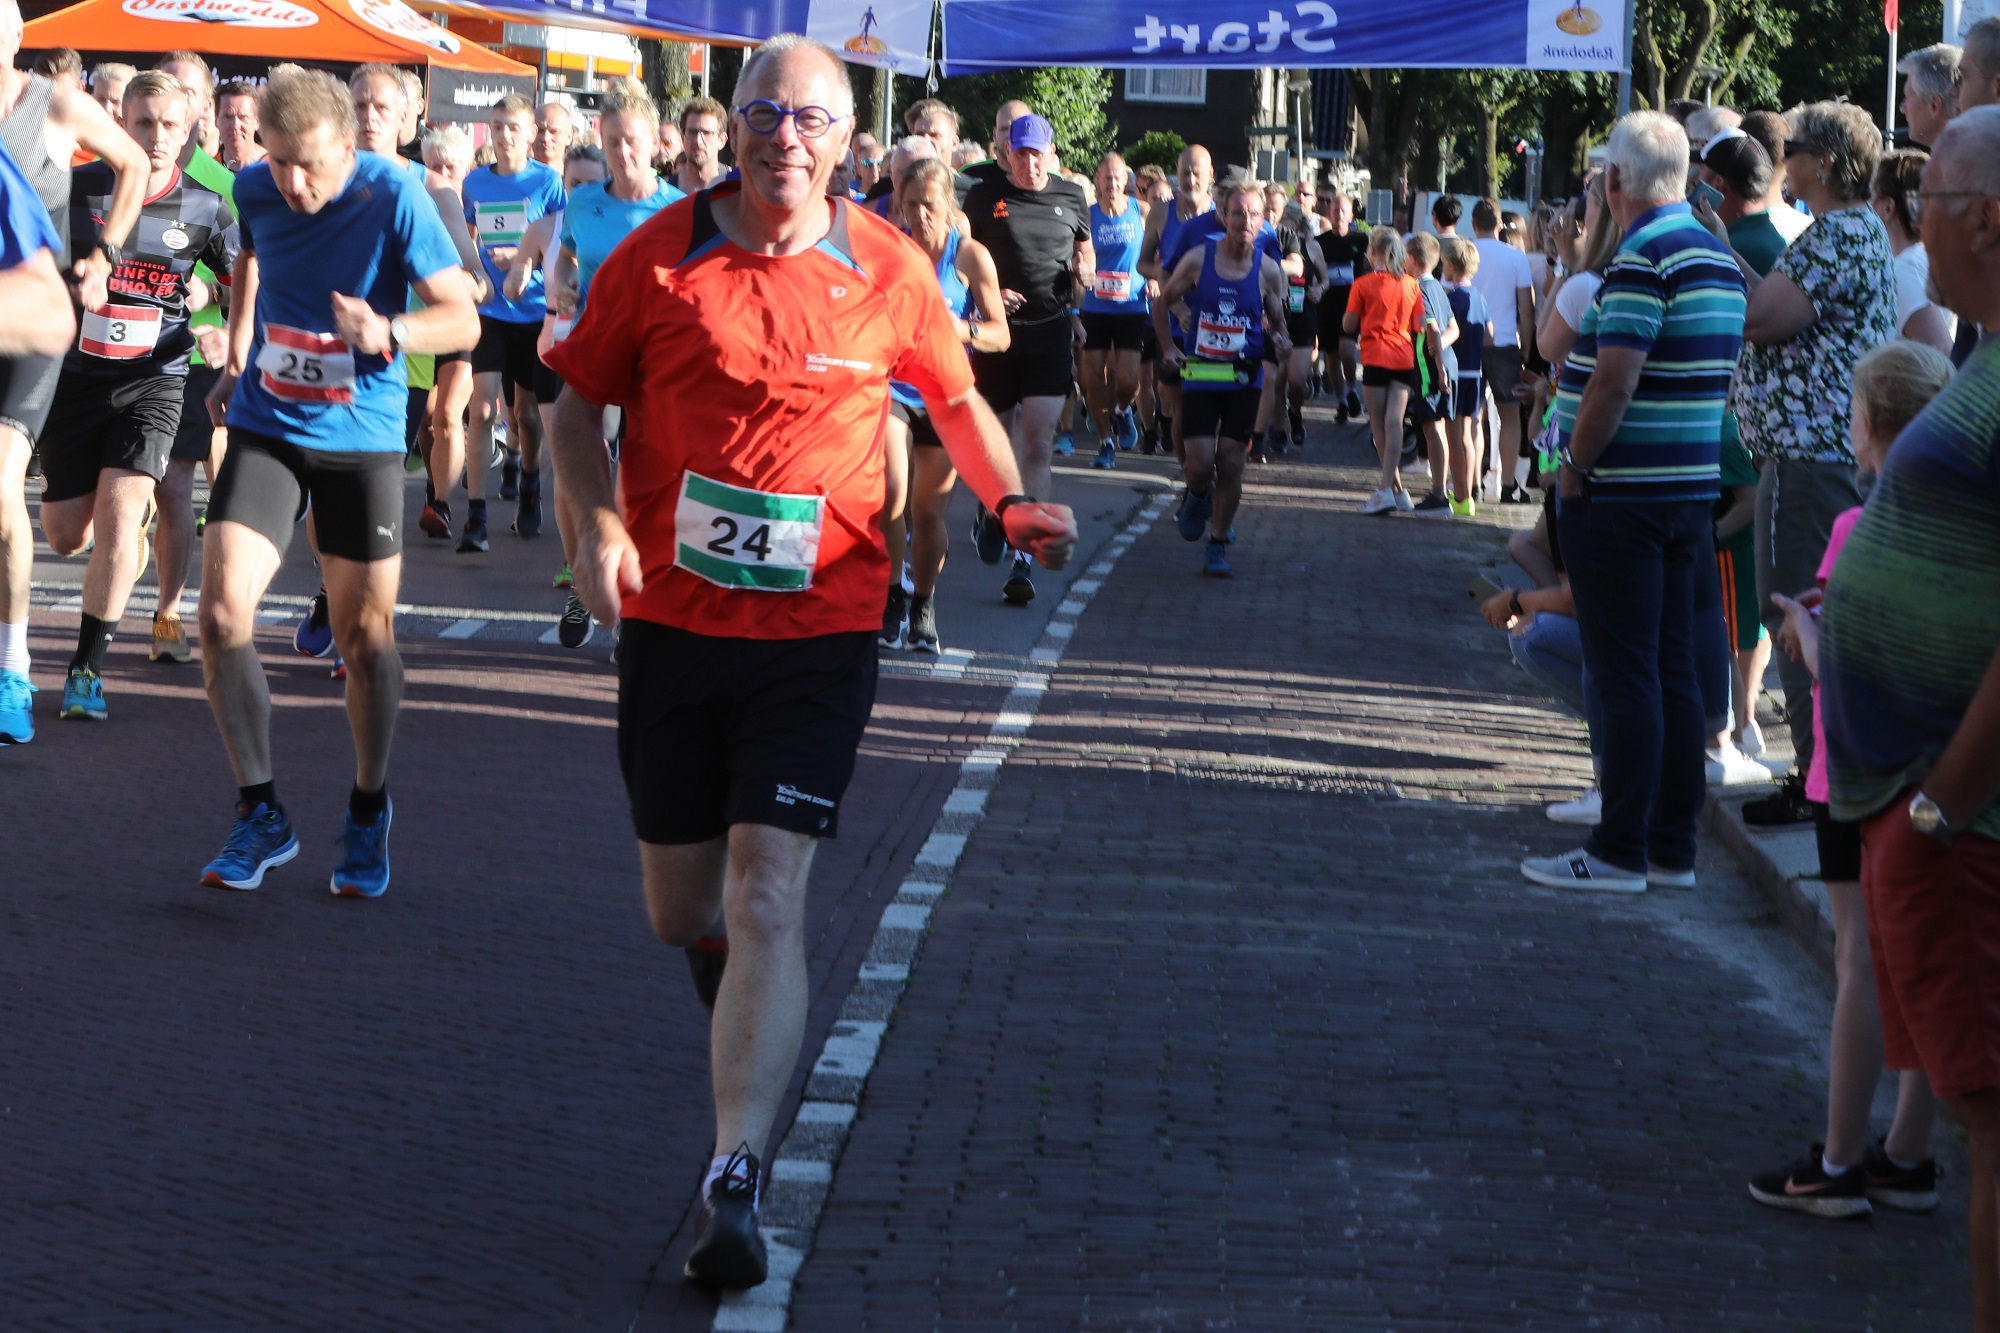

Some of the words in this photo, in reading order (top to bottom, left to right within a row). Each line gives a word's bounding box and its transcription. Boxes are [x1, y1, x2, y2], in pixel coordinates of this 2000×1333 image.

[109, 321, 127, 342] 3
[278, 353, 323, 382] 25
[707, 516, 772, 561] 24
